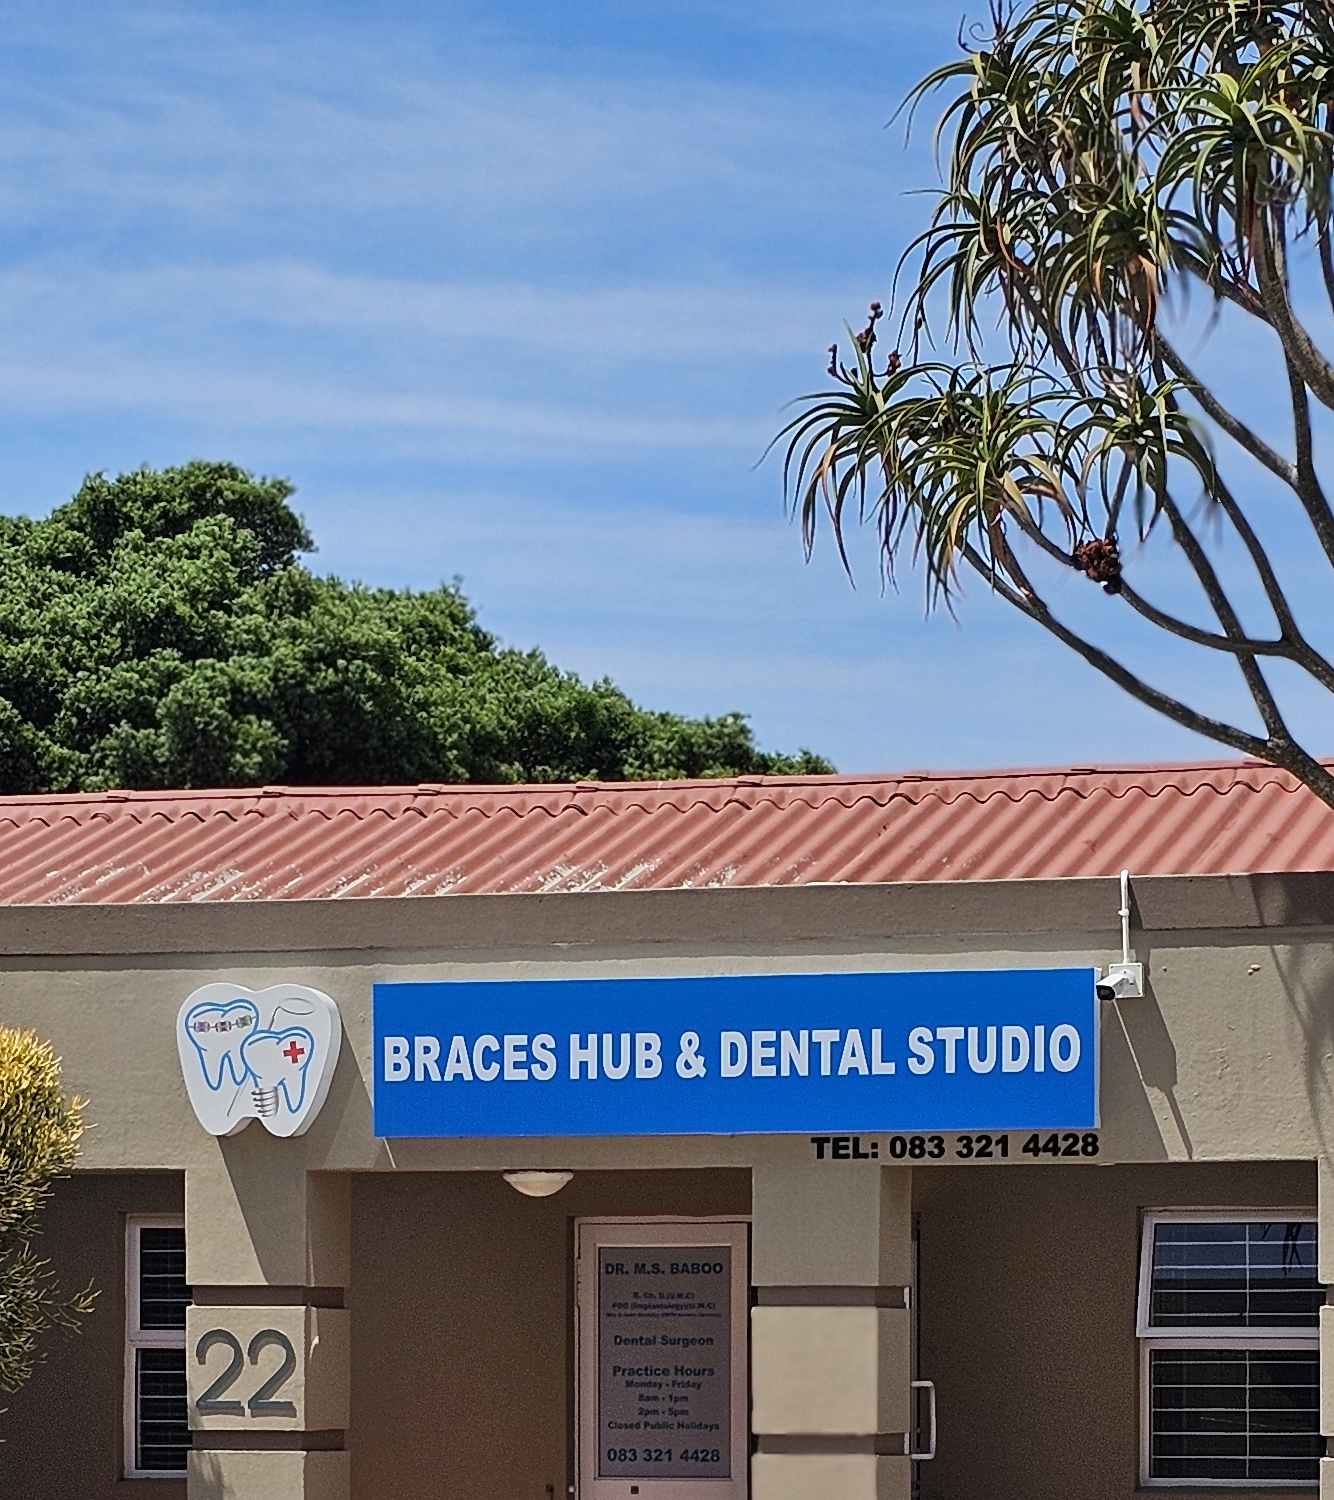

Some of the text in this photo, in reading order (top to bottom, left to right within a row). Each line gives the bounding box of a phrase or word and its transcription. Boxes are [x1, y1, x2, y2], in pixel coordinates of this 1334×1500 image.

[384, 1024, 1082, 1082] BRACES HUB & DENTAL STUDIO
[810, 1133, 1100, 1160] TEL: 083 321 4428
[605, 1262, 724, 1275] DR. M.S. BABOO
[614, 1335, 715, 1348] Dental Surgeon
[196, 1328, 296, 1413] 22
[612, 1365, 715, 1377] Practice Hours
[625, 1380, 663, 1390] Monday
[671, 1380, 703, 1390] Friday
[638, 1393, 659, 1402] 8am
[668, 1394, 689, 1404] 1pm
[638, 1407, 659, 1417] 2pm
[668, 1407, 689, 1417] 5pm
[608, 1420, 720, 1431] Closed Public Holidays
[607, 1448, 721, 1463] 083 321 4428
